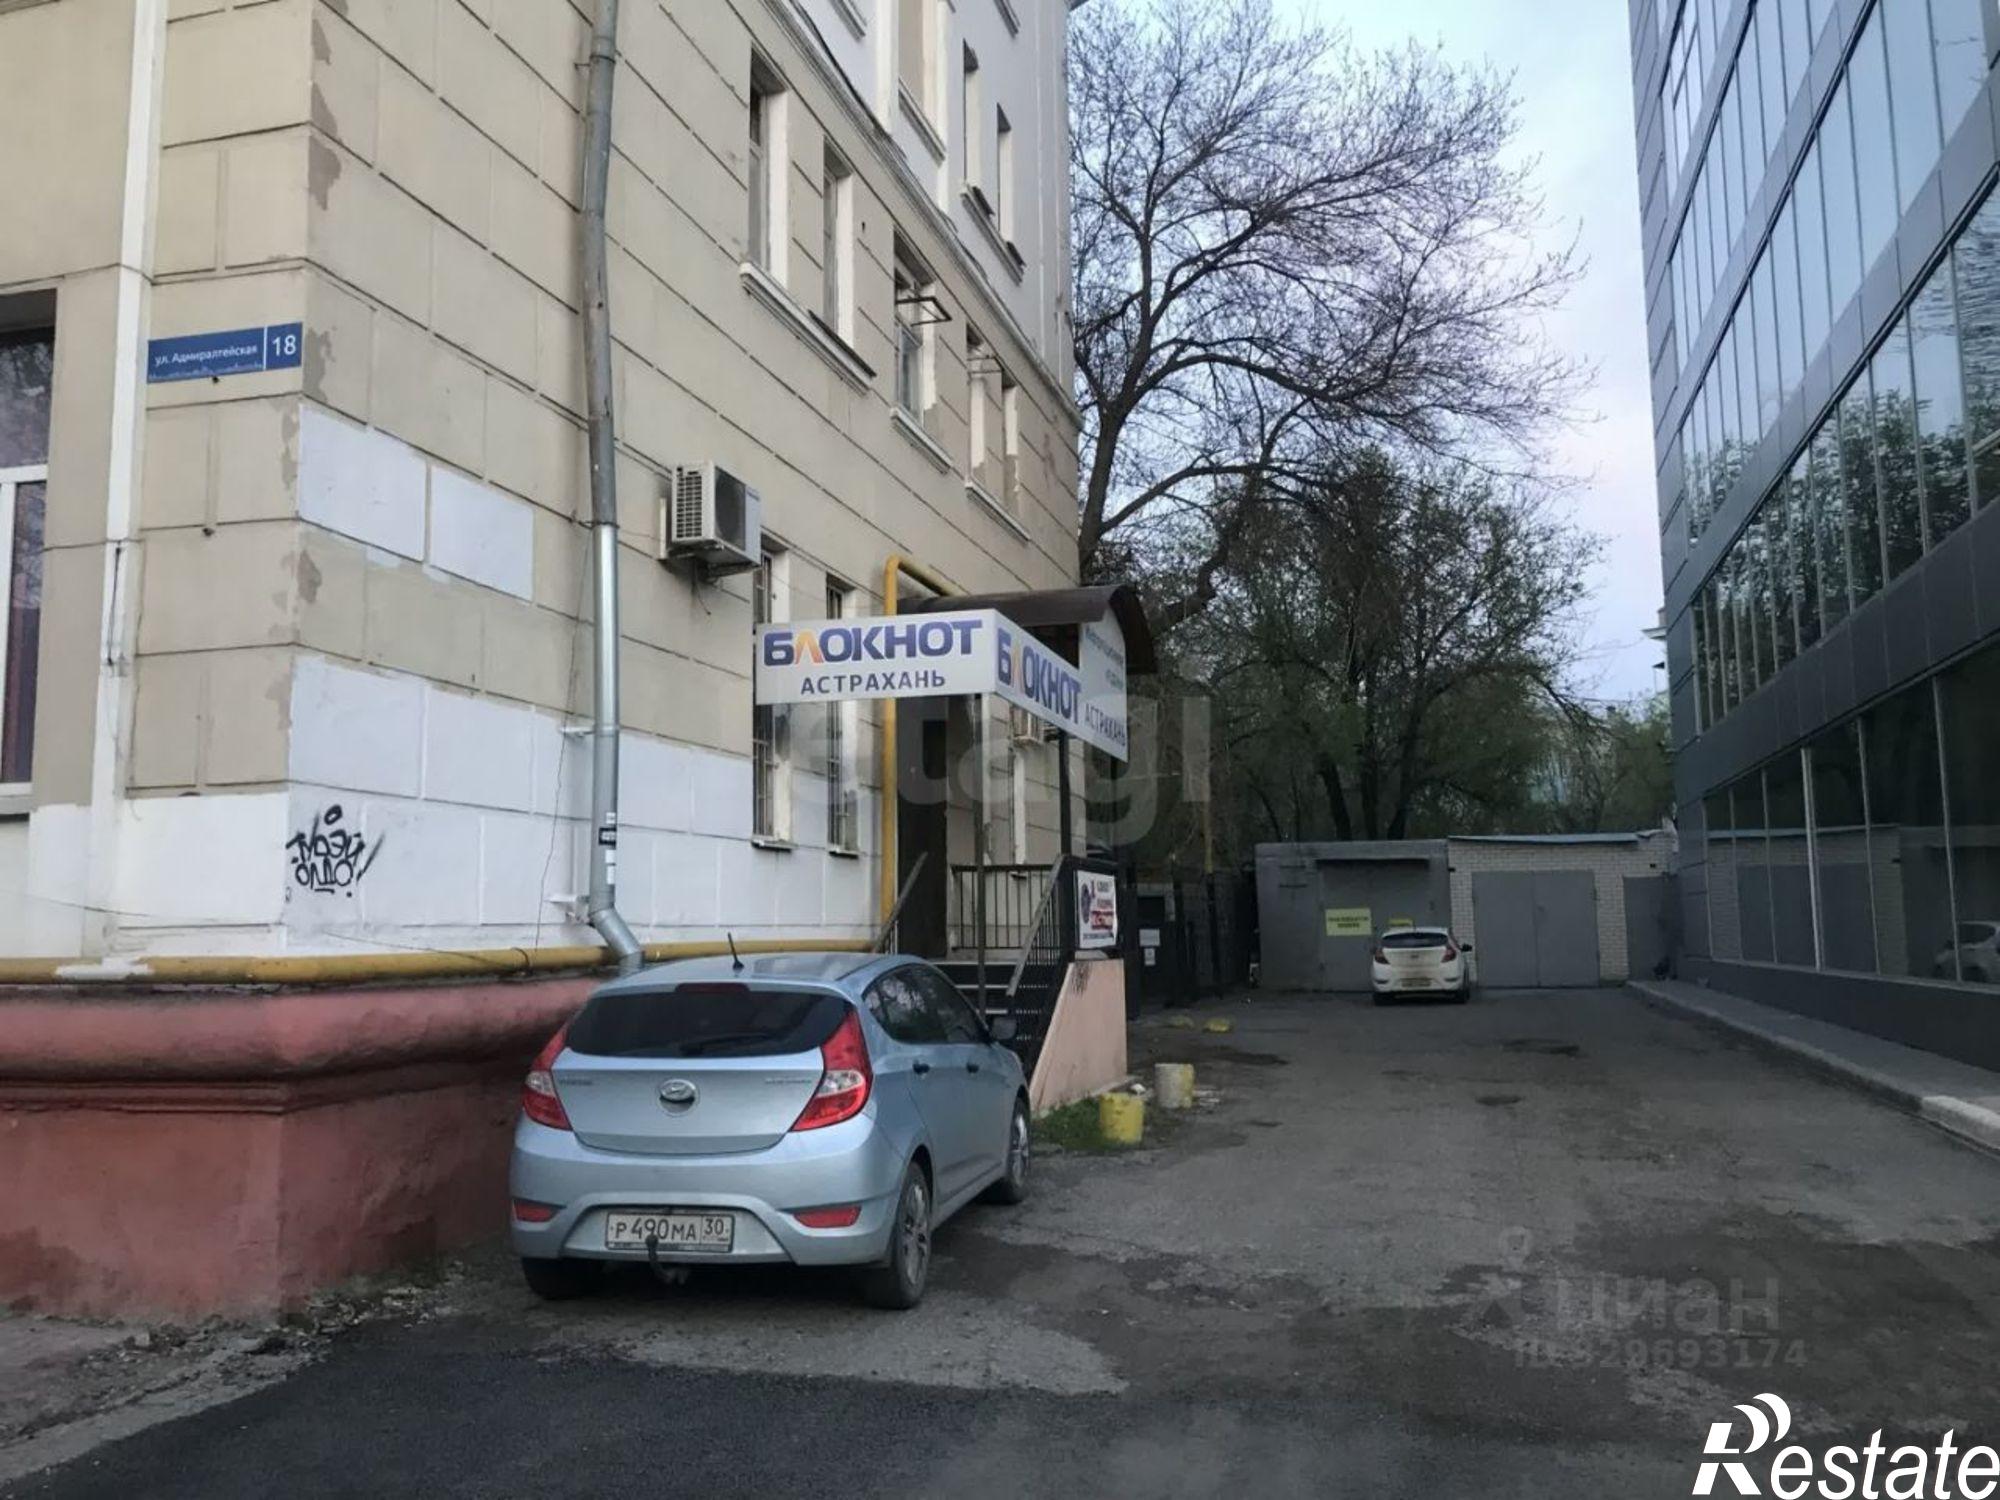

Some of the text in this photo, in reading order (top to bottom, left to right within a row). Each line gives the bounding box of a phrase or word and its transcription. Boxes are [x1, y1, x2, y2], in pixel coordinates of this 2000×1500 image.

[155, 344, 258, 367] ул. Адмиралтейская
[272, 334, 297, 356] 18
[763, 619, 983, 667] БЛОКНОТ
[801, 669, 945, 695] АСТРАХАНЬ
[998, 626, 1082, 725] БЛОКНОТ
[704, 1217, 725, 1236] 30
